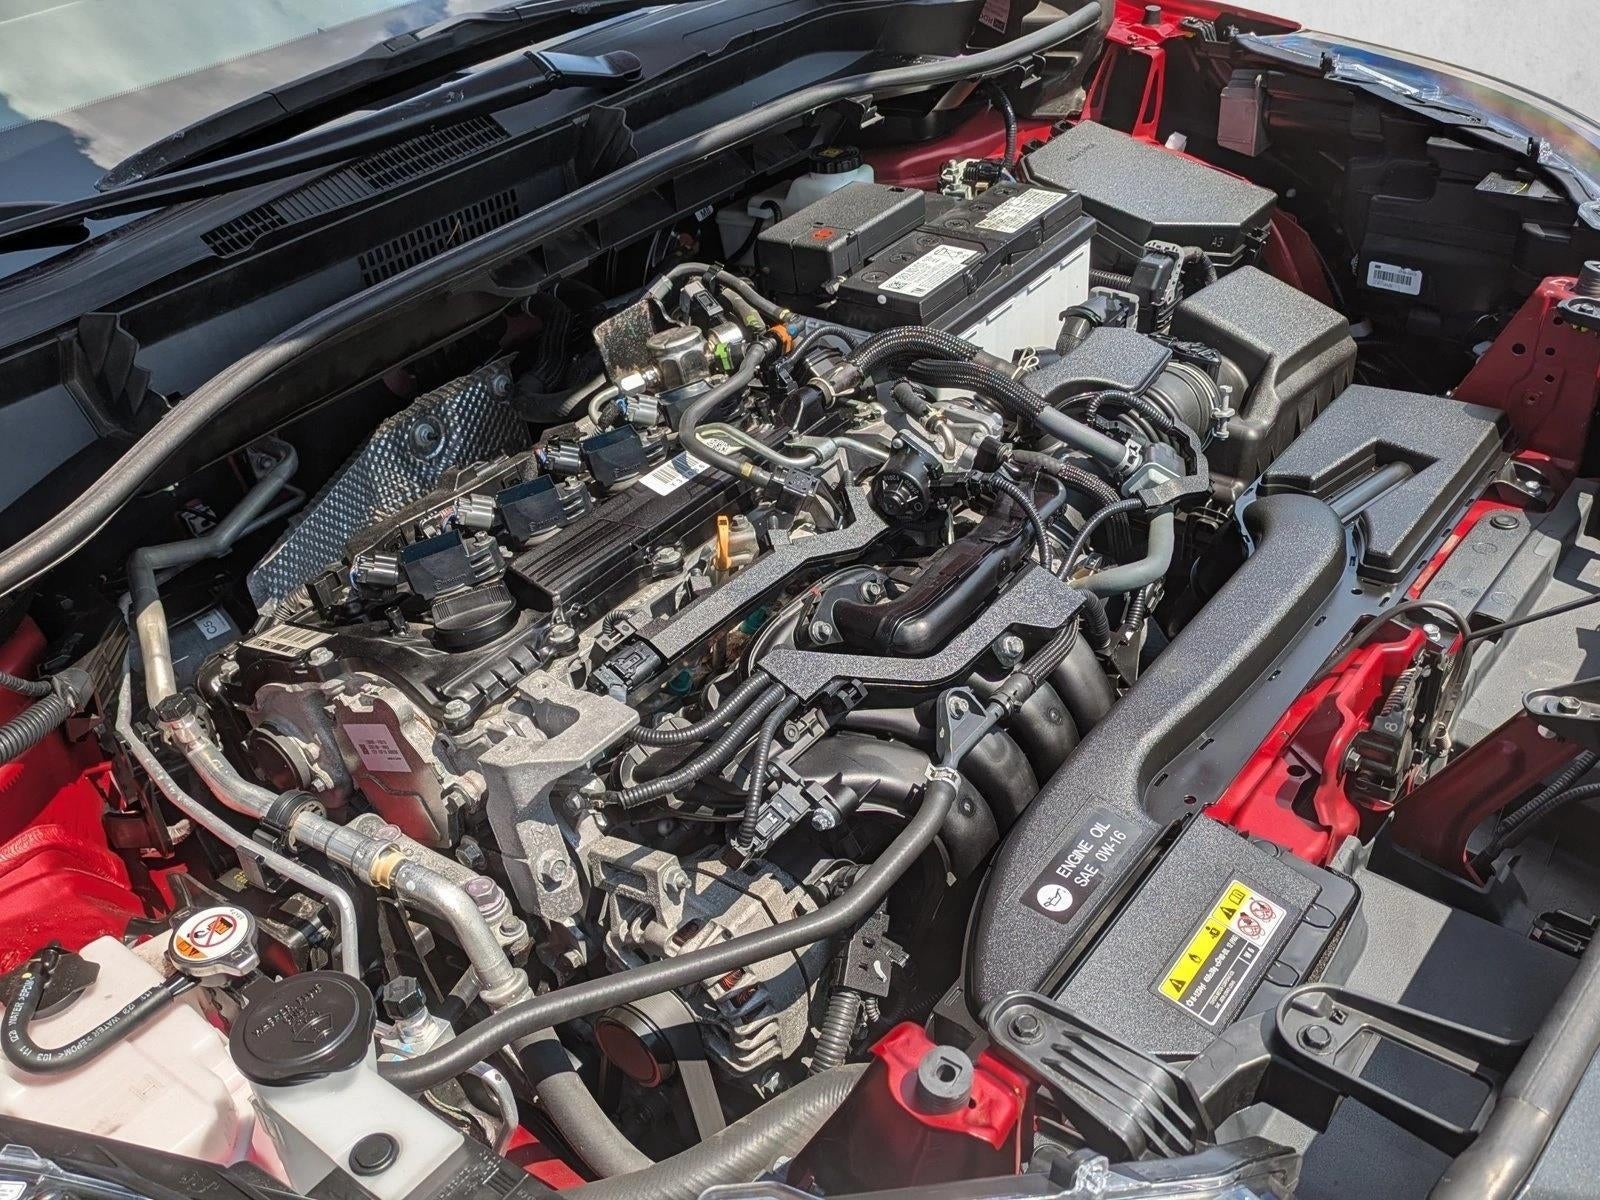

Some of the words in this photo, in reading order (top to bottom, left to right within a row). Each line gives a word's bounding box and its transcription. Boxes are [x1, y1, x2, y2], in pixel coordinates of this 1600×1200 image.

[203, 620, 217, 634] C5
[1056, 839, 1094, 878] ENGINE
[1089, 821, 1111, 838] OIL
[1074, 863, 1099, 887] SAE
[1095, 830, 1127, 862] 0W-16
[8, 1002, 24, 1026] WATER
[91, 1016, 121, 1038] WATER
